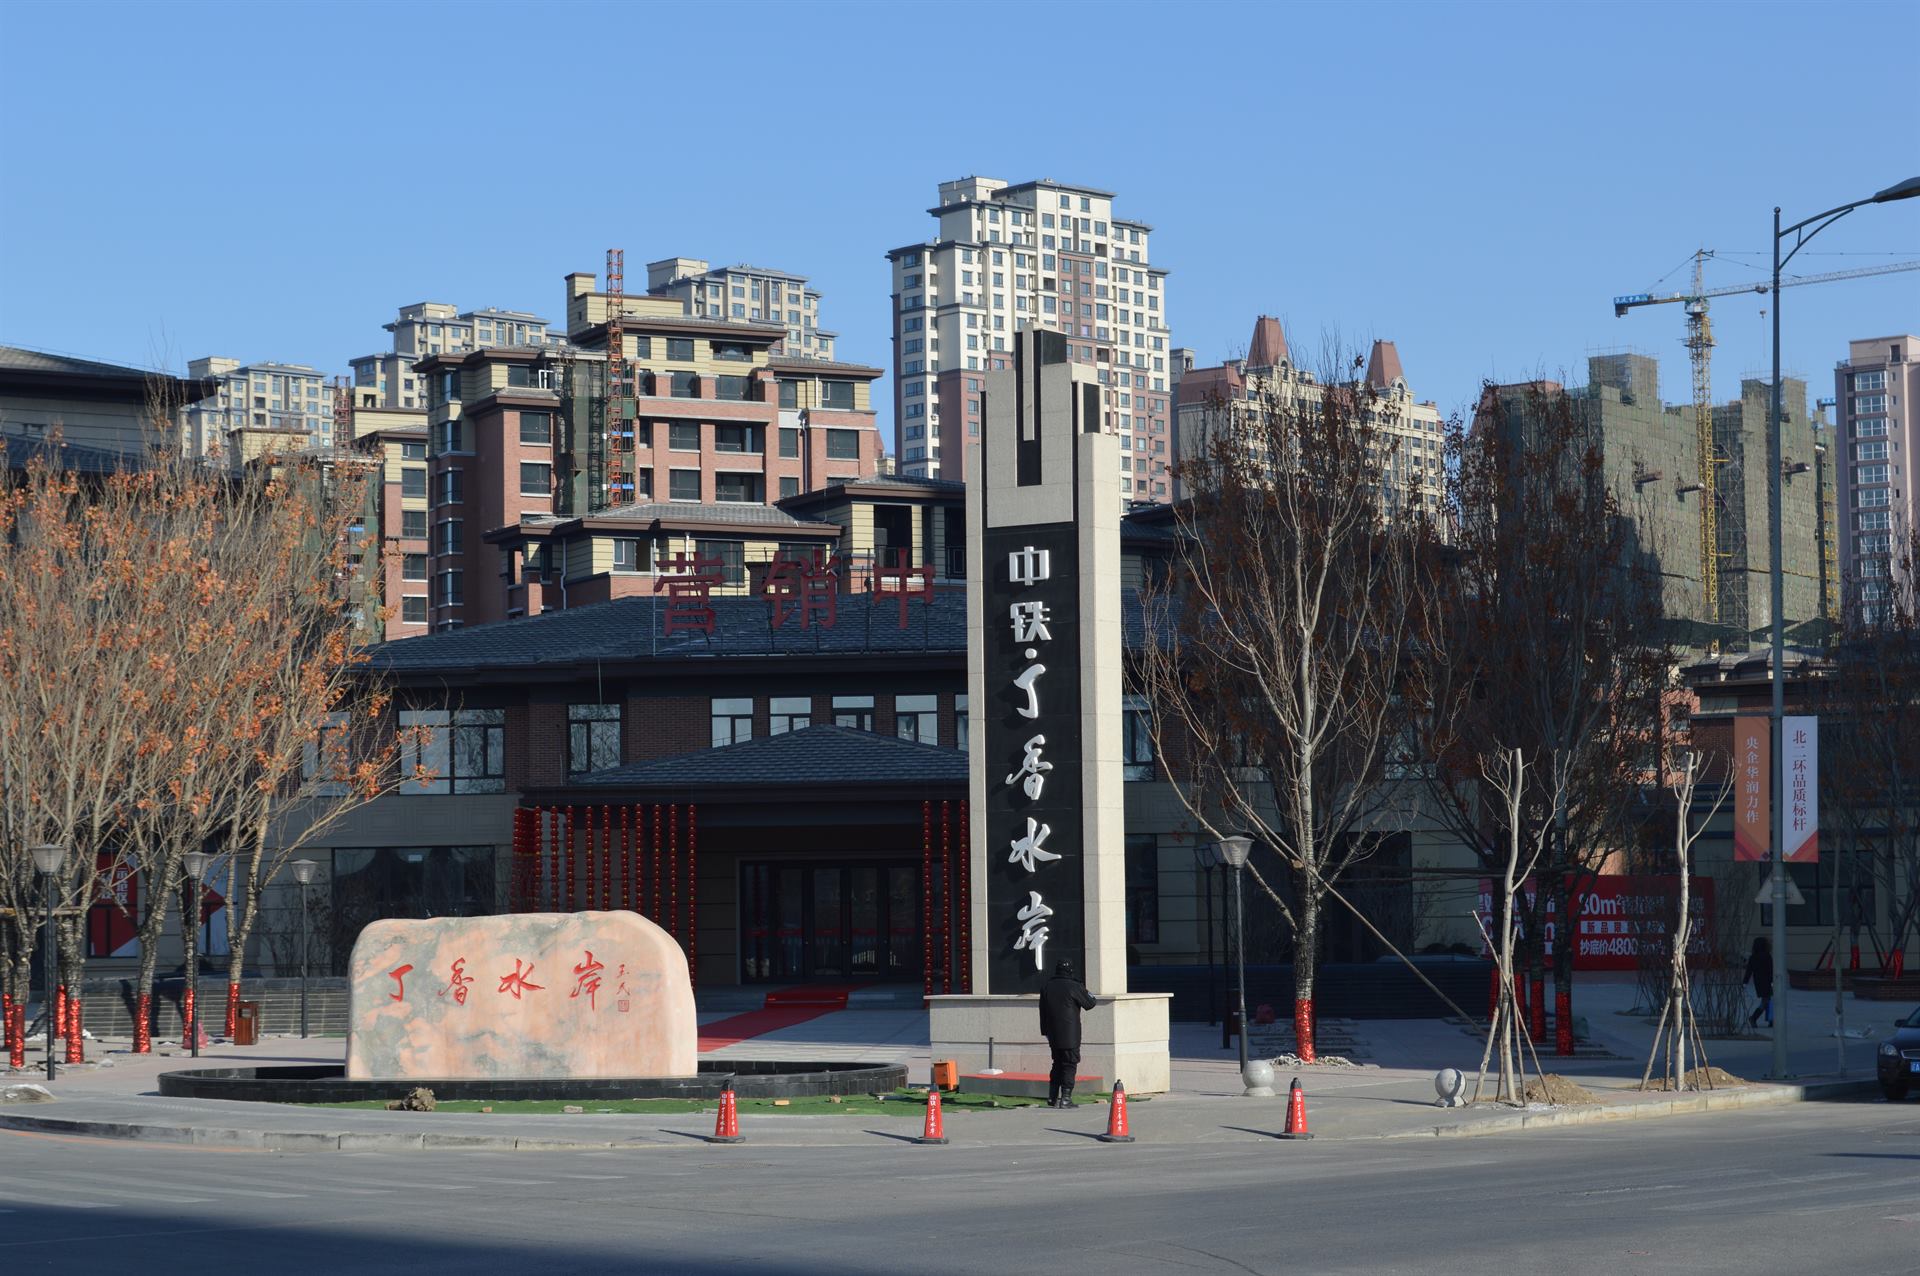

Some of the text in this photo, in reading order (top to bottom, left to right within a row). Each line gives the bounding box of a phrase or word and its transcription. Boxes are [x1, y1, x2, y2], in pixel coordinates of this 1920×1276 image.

[654, 547, 936, 636] 营销中
[1792, 729, 1807, 832] 北二环品质标杆
[388, 950, 605, 1011] 丁香水岸
